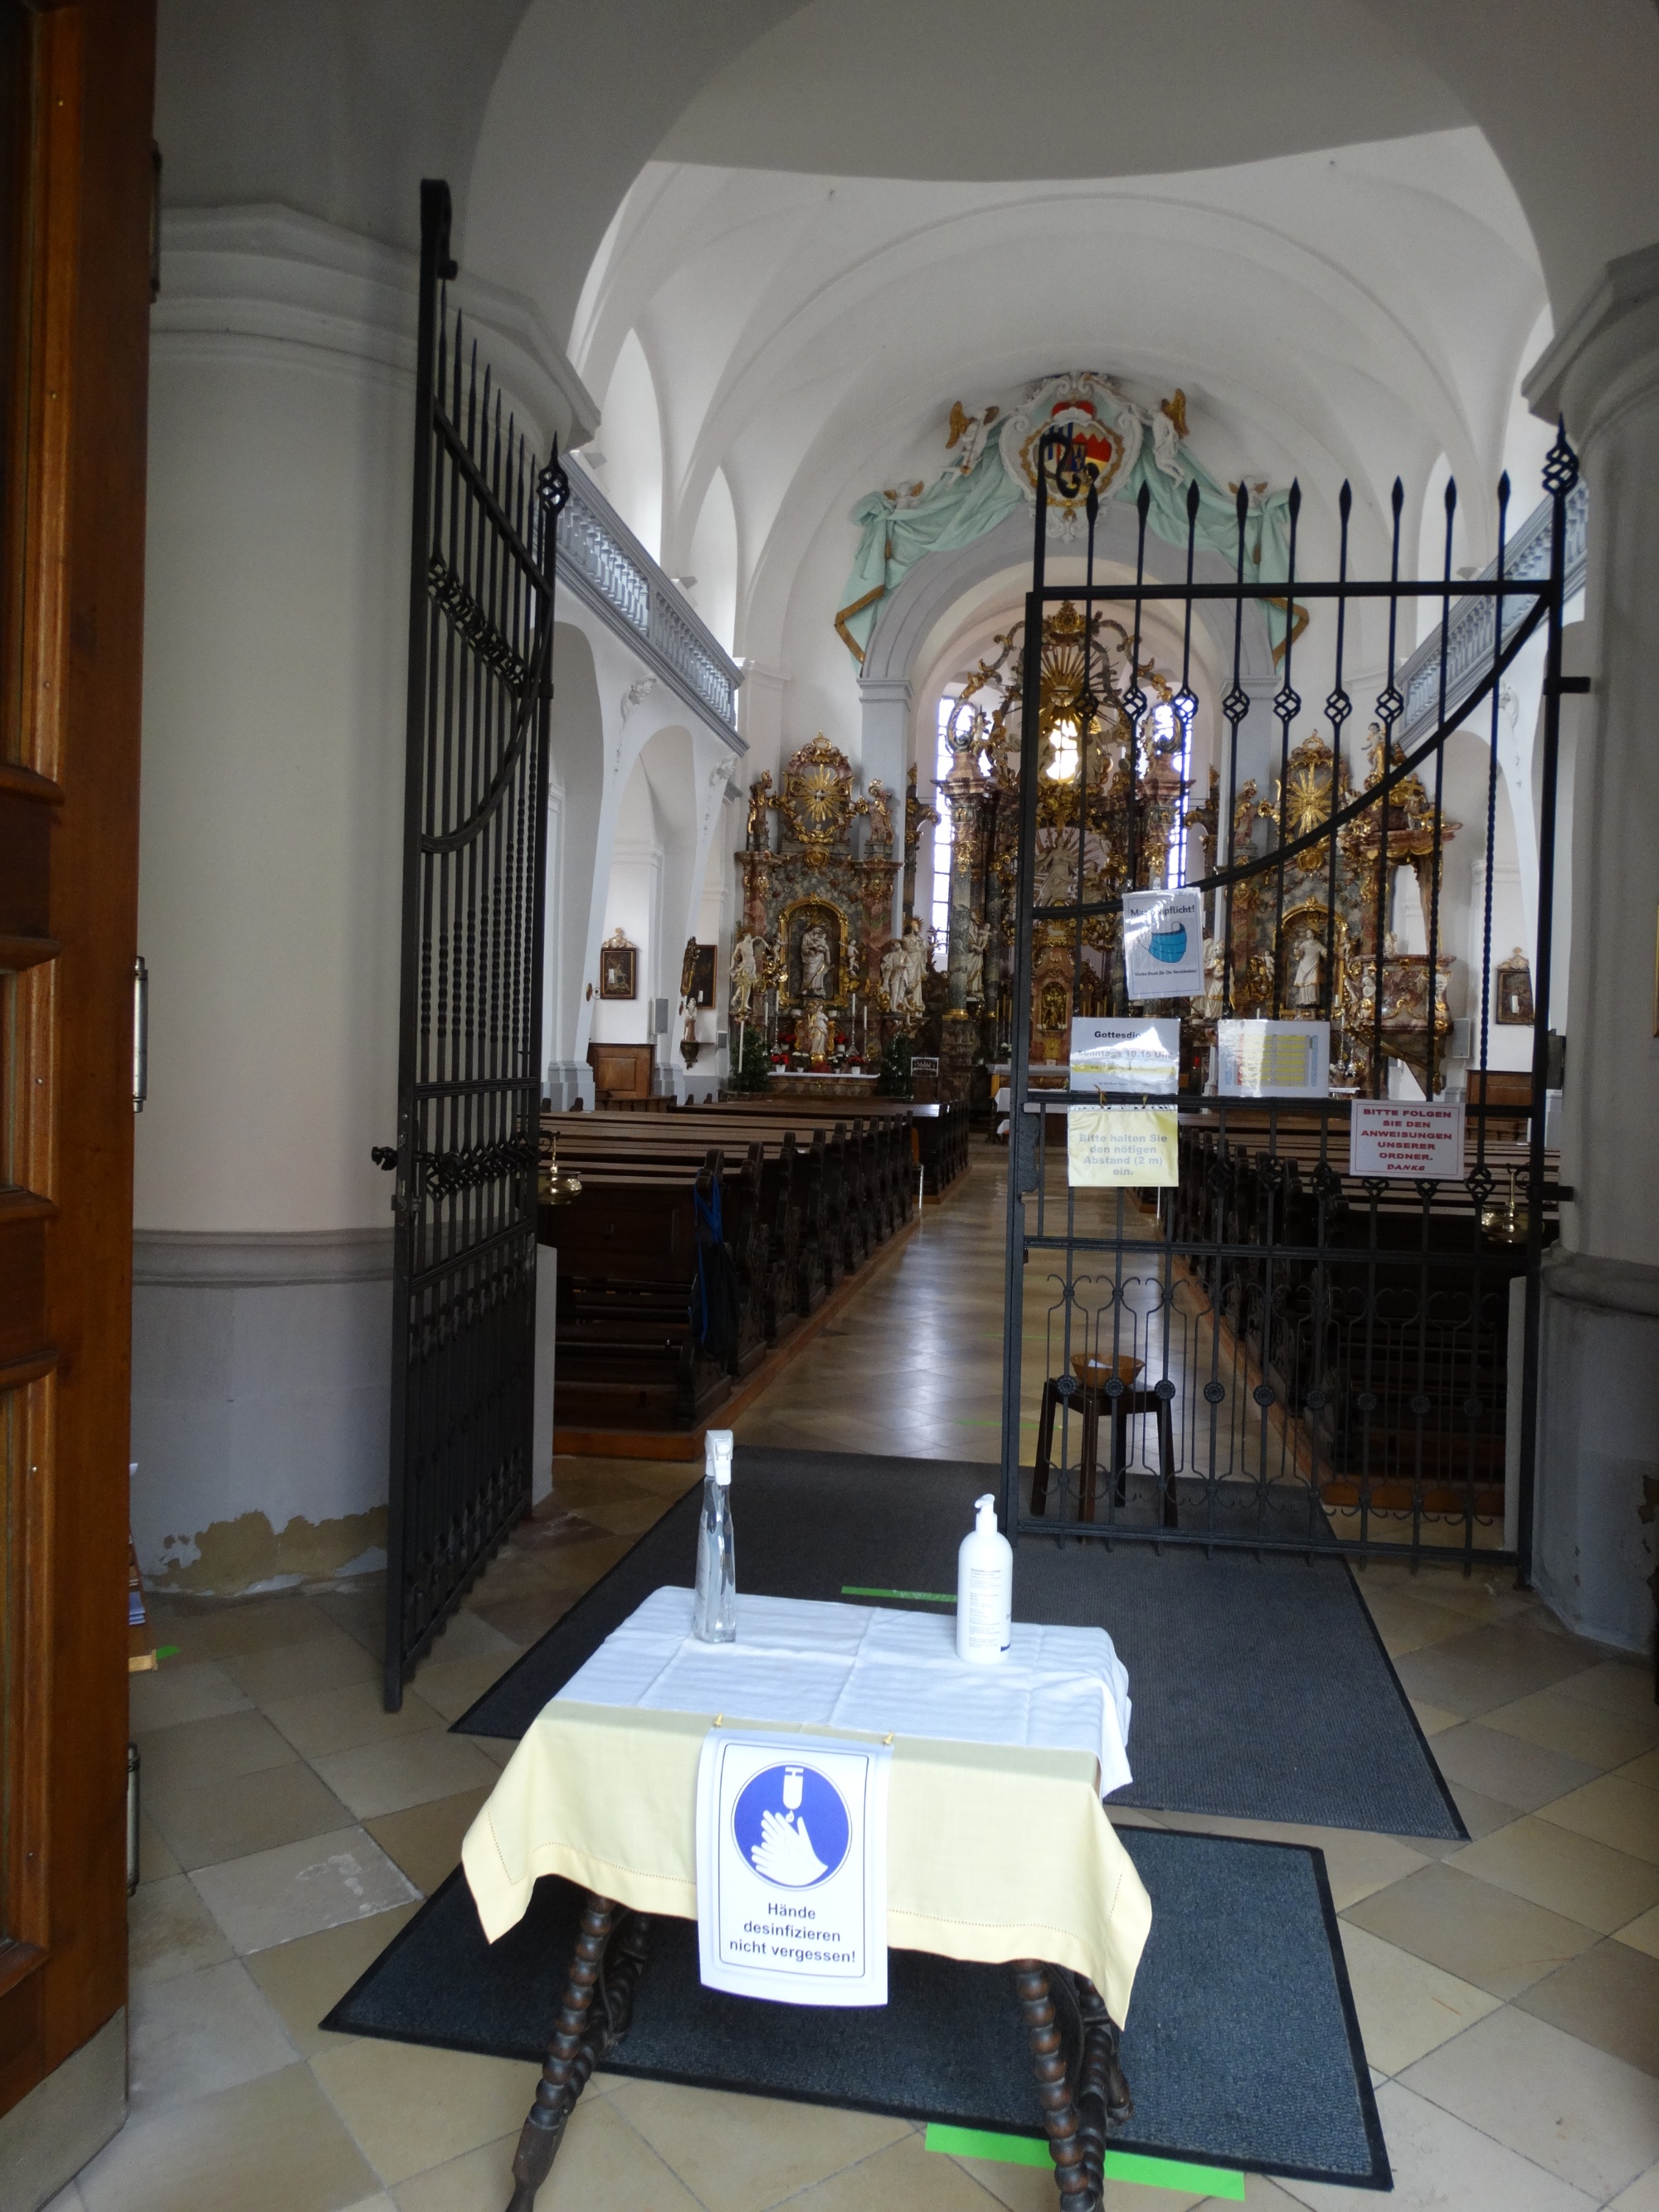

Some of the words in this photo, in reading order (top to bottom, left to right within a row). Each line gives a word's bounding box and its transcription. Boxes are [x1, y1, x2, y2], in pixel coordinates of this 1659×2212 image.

[1130, 904, 1195, 916] Mapflicht!
[1125, 1049, 1151, 1058] 10.15
[1363, 1108, 1399, 1116] BITTE
[1403, 1110, 1452, 1118] FOLGEN
[1079, 1133, 1107, 1142] Bitte
[1110, 1133, 1146, 1142] halten
[1149, 1133, 1168, 1142] Sie
[1360, 1130, 1452, 1140] ANWEISUNGEN
[1089, 1145, 1111, 1154] den
[1113, 1145, 1157, 1155] nötigen
[1377, 1141, 1436, 1150] UNSERER
[1083, 1155, 1131, 1164] Abstand
[1133, 1156, 1146, 1166] (2
[1148, 1156, 1163, 1166] m)
[1379, 1152, 1433, 1161] ORDNER.
[1112, 1166, 1134, 1175] ein.
[767, 1902, 816, 1920] Hände
[743, 1920, 841, 1942] desinfizieren
[729, 1938, 767, 1955] nicht
[771, 1946, 856, 1963] vergessen!
